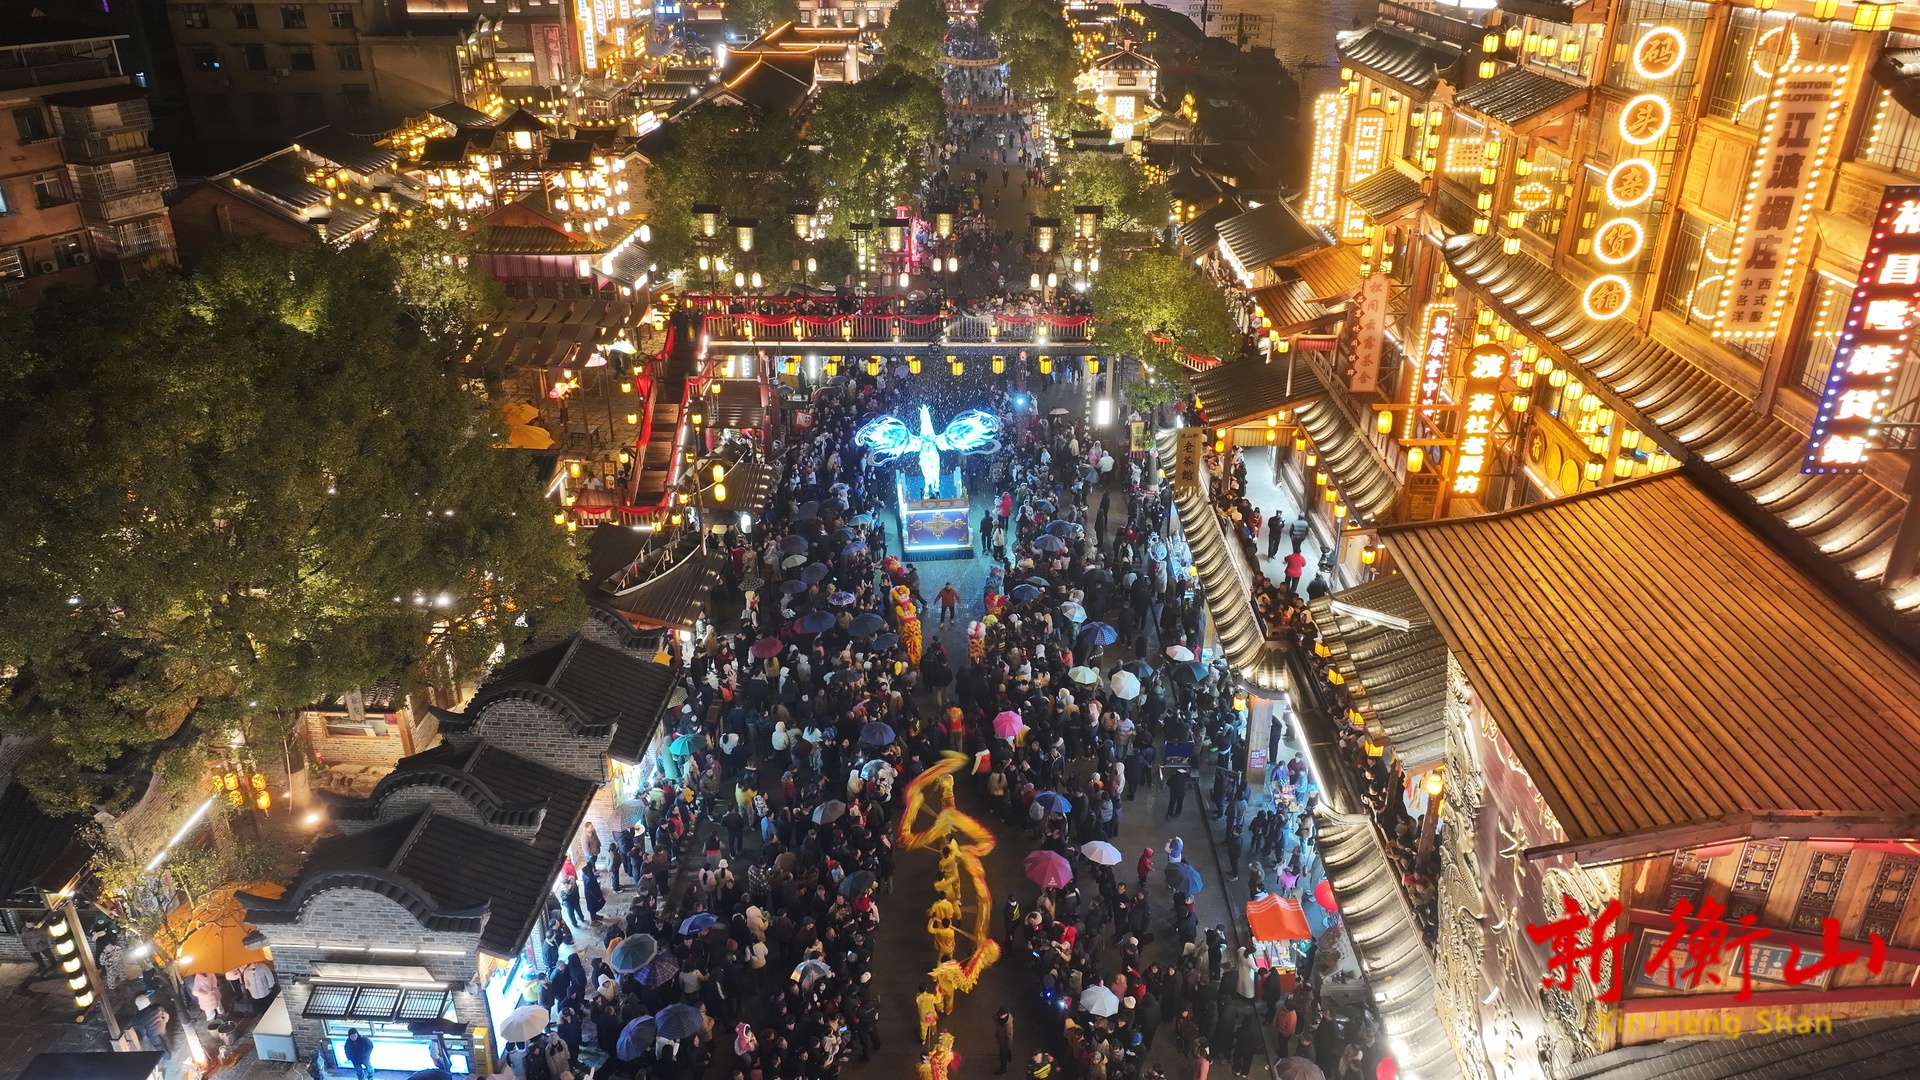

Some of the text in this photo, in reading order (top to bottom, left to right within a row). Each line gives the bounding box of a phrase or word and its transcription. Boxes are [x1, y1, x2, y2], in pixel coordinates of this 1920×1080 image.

[1785, 80, 1833, 90] CUSTOM
[1591, 36, 1677, 311] 码头杂货铺
[1741, 278, 1772, 290] 中西
[1736, 294, 1767, 307] 各式
[1731, 311, 1763, 323] 洋服
